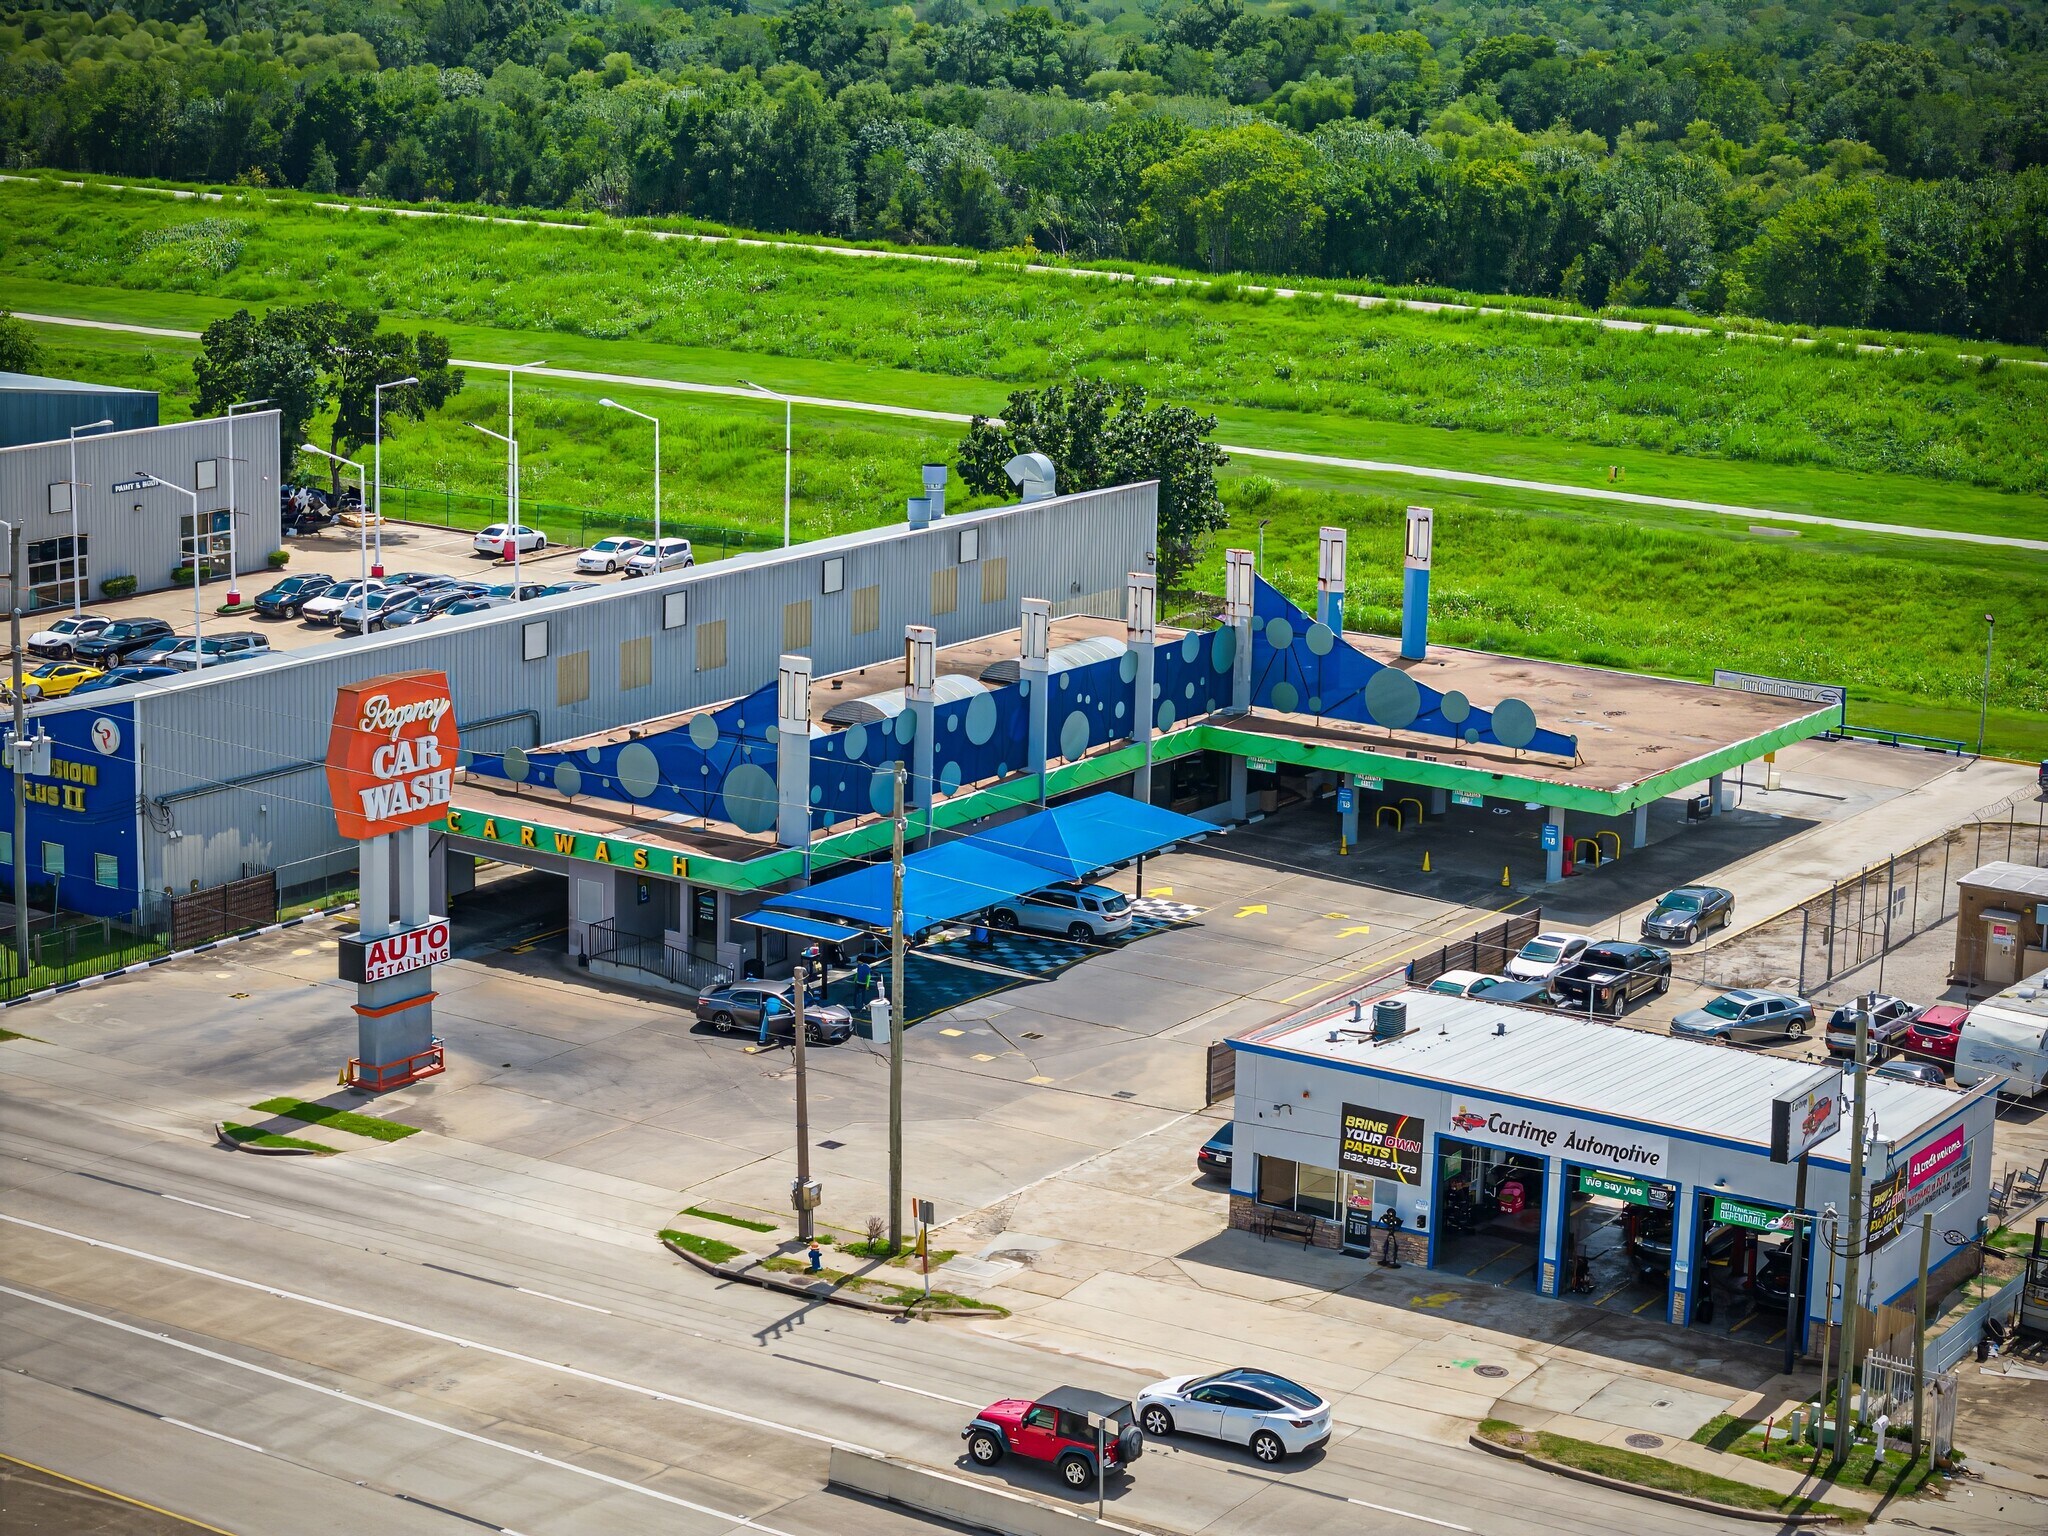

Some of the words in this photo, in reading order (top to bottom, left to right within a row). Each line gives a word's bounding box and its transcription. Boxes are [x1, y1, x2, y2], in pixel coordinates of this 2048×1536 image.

[359, 694, 450, 742] Regency
[372, 735, 441, 780] CAR
[24, 780, 60, 807] LUS
[359, 768, 452, 821] WASH
[367, 924, 448, 968] AUTO
[367, 948, 449, 981] DETAILING
[1345, 1115, 1389, 1134] BRING
[1346, 1127, 1383, 1145] YOUR
[1385, 1136, 1421, 1153] OWN
[1488, 1112, 1557, 1147] Cartime
[1563, 1130, 1660, 1166] Automotive
[1344, 1139, 1391, 1159] PARTS
[1585, 1176, 1602, 1188] We
[1604, 1182, 1622, 1193] say
[1624, 1186, 1643, 1196] yes
